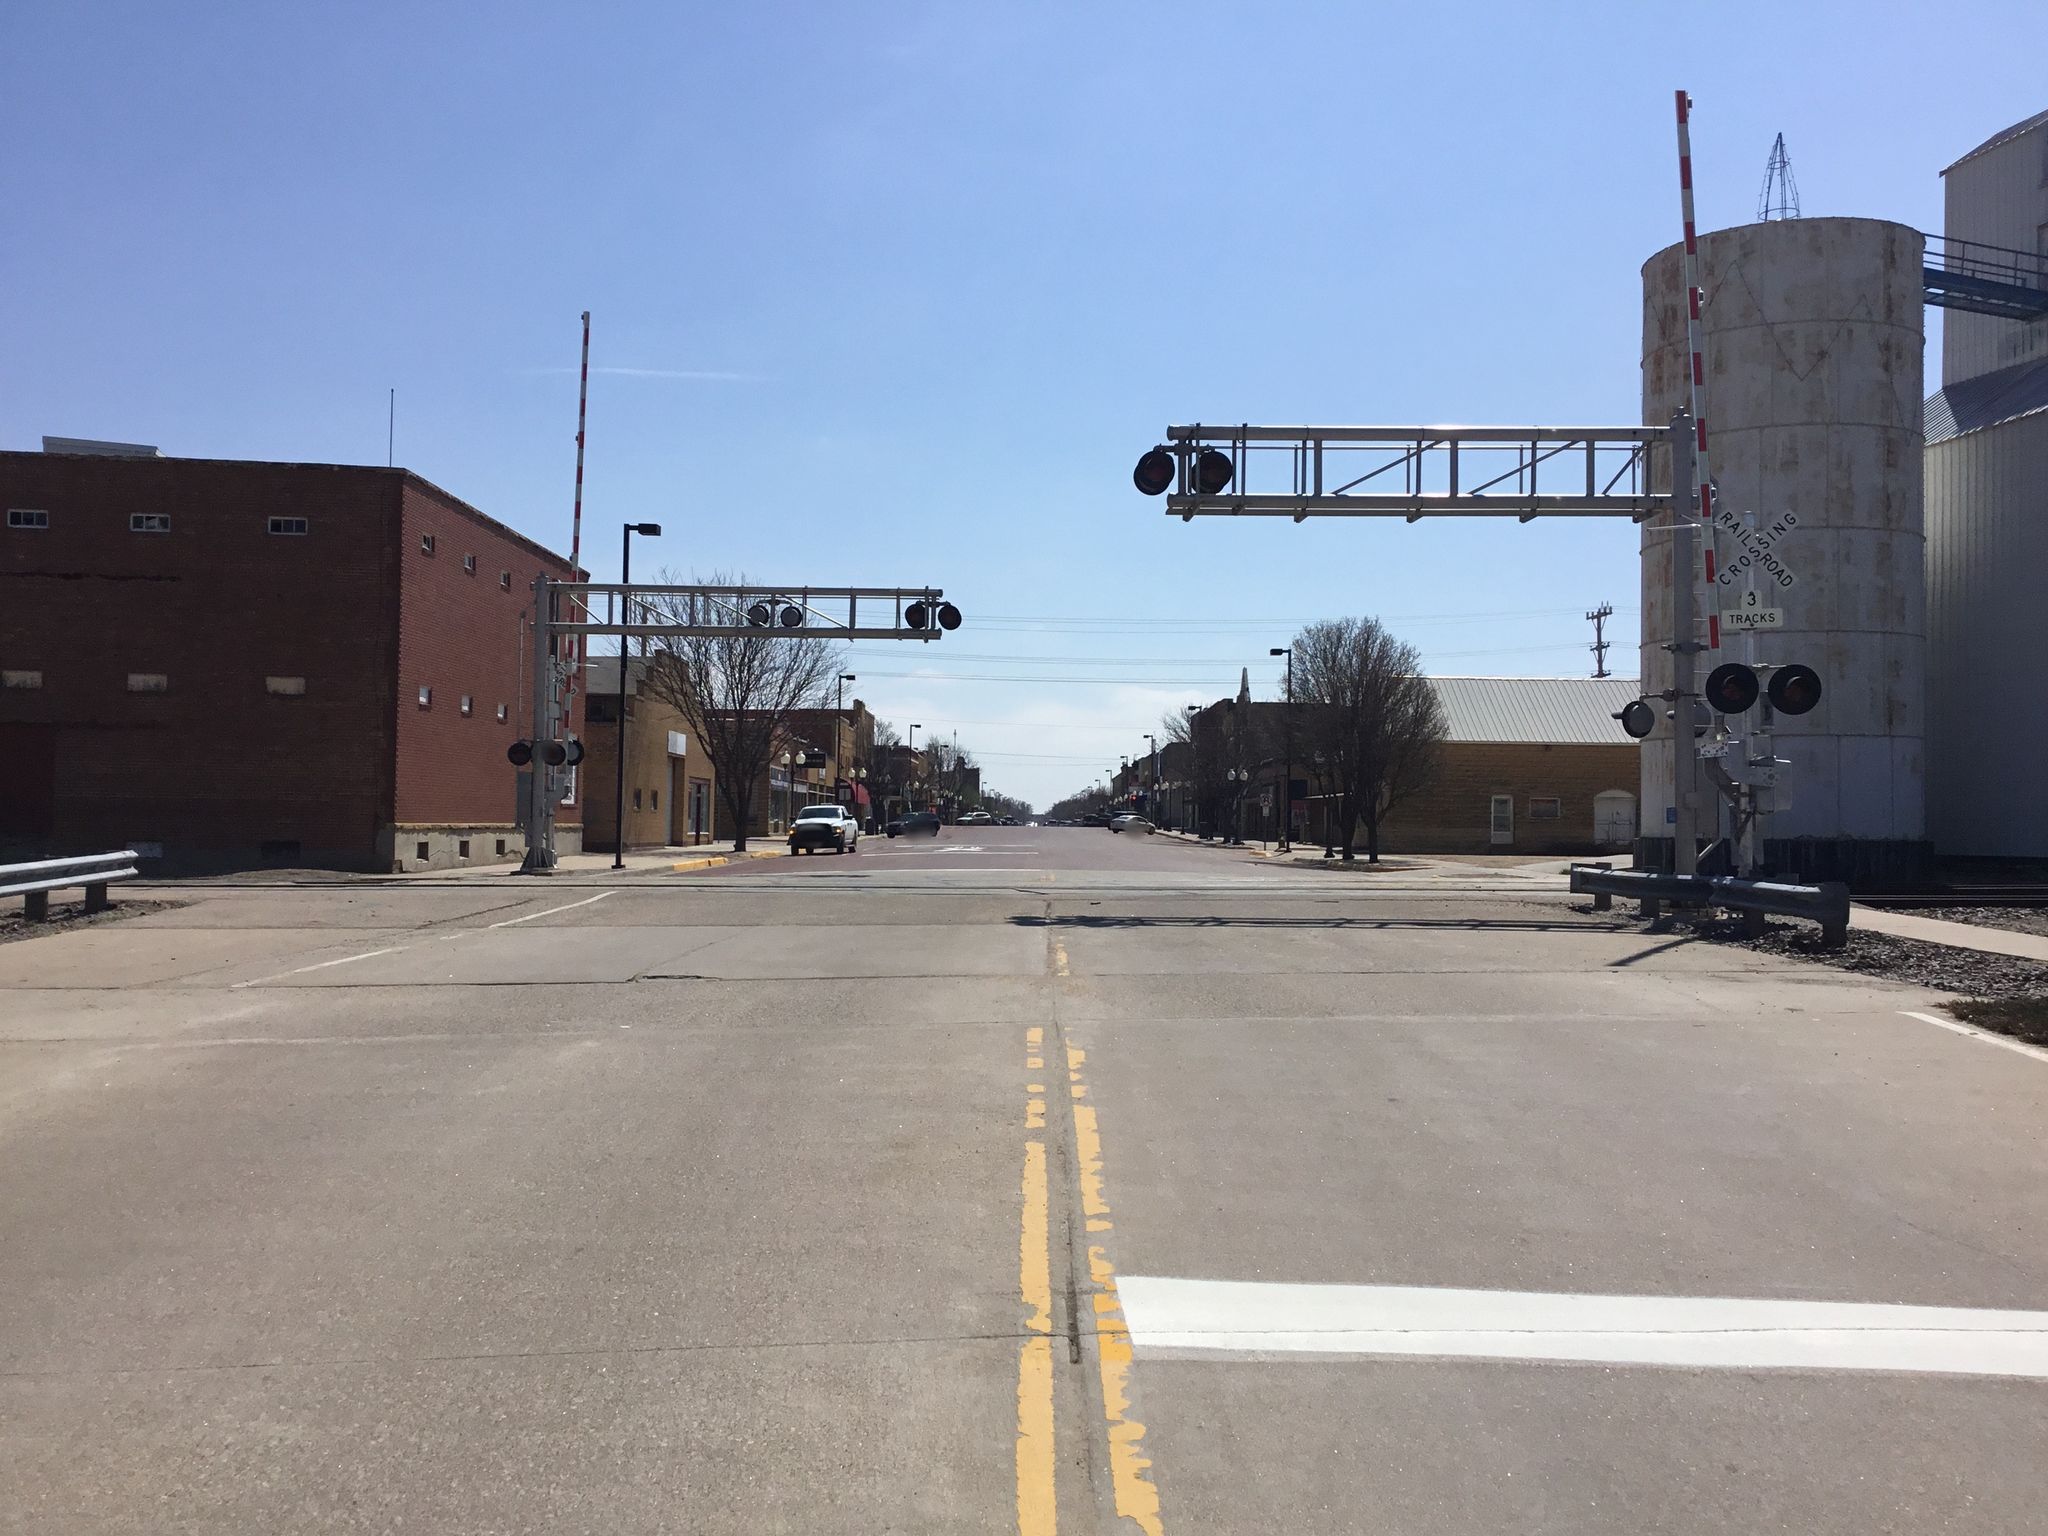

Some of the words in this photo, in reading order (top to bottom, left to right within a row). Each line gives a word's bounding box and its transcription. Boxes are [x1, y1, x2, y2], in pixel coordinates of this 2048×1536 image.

[1719, 514, 1796, 585] CROSSING
[1720, 512, 1793, 587] RAILROAD
[1729, 613, 1776, 624] TRACKS
[1747, 591, 1756, 606] 3
